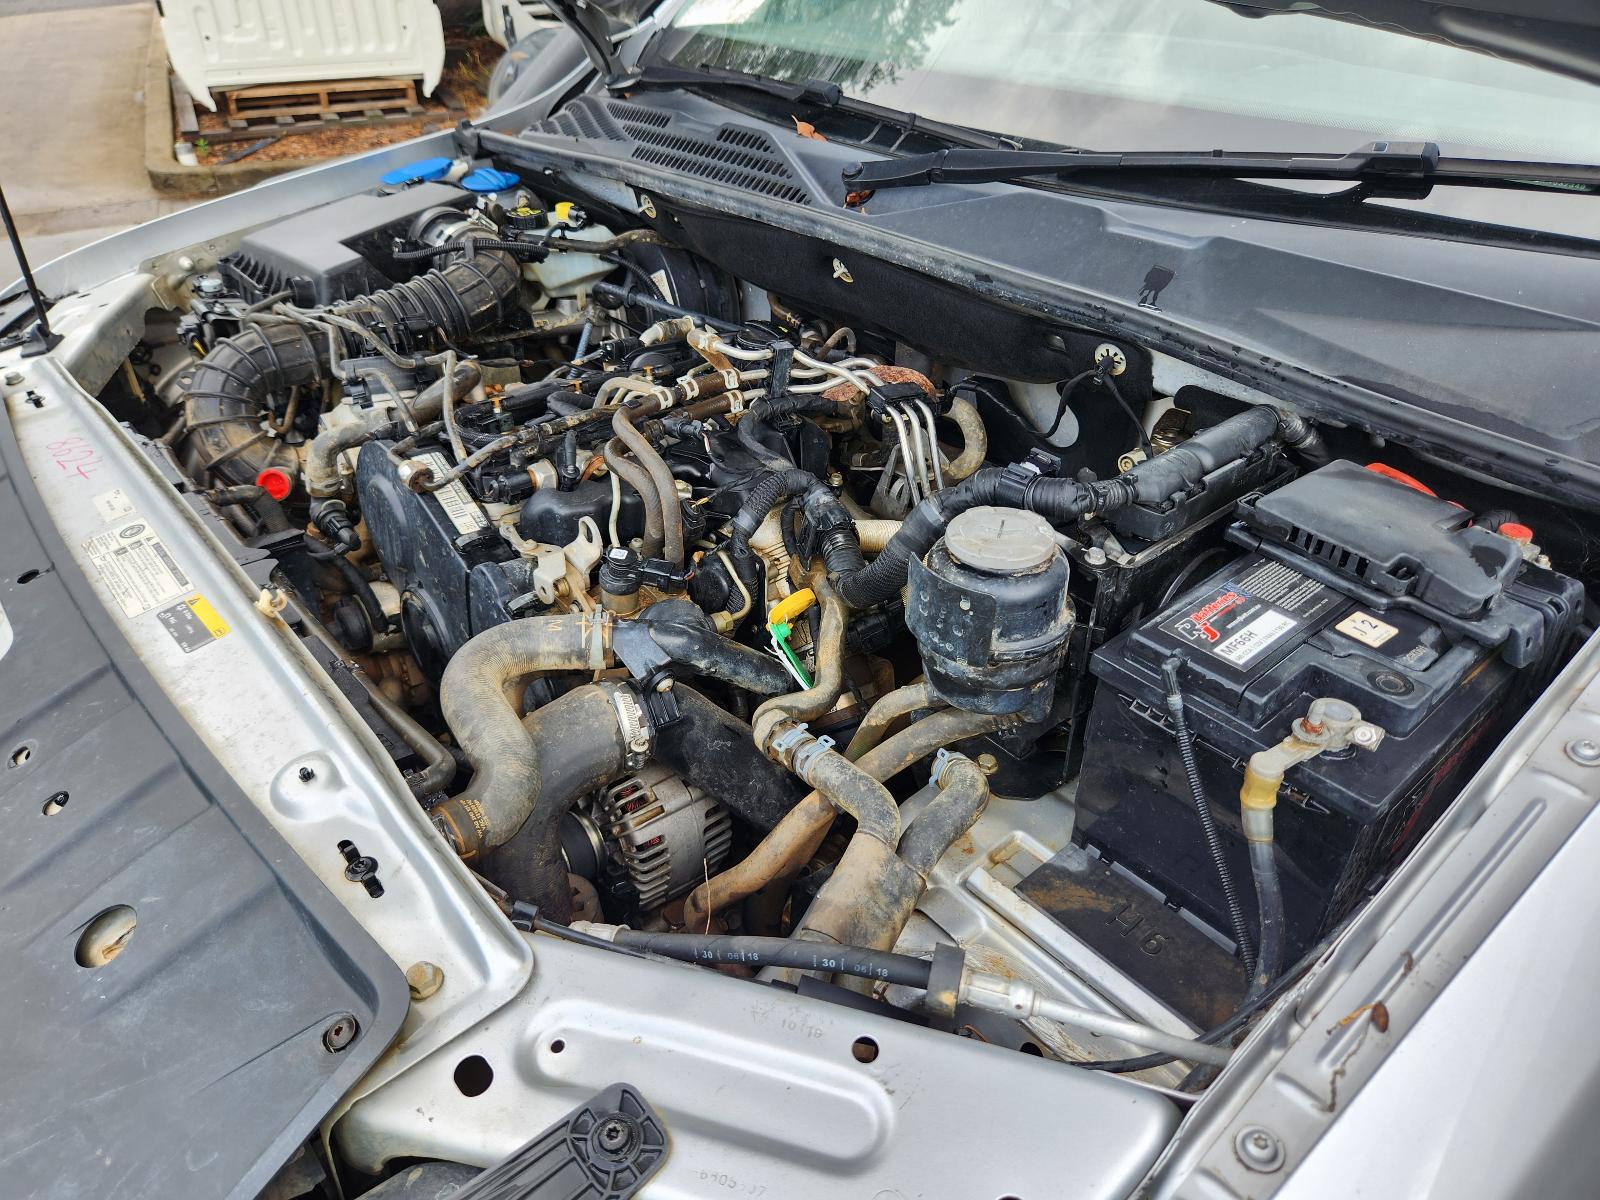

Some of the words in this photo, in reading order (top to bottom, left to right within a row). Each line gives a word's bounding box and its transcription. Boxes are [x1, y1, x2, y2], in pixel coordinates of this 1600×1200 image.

[46, 436, 104, 479] 8624
[1190, 591, 1239, 623] Batteries
[1220, 630, 1258, 656] MF66H
[822, 958, 836, 968] 30
[876, 968, 888, 977] 18
